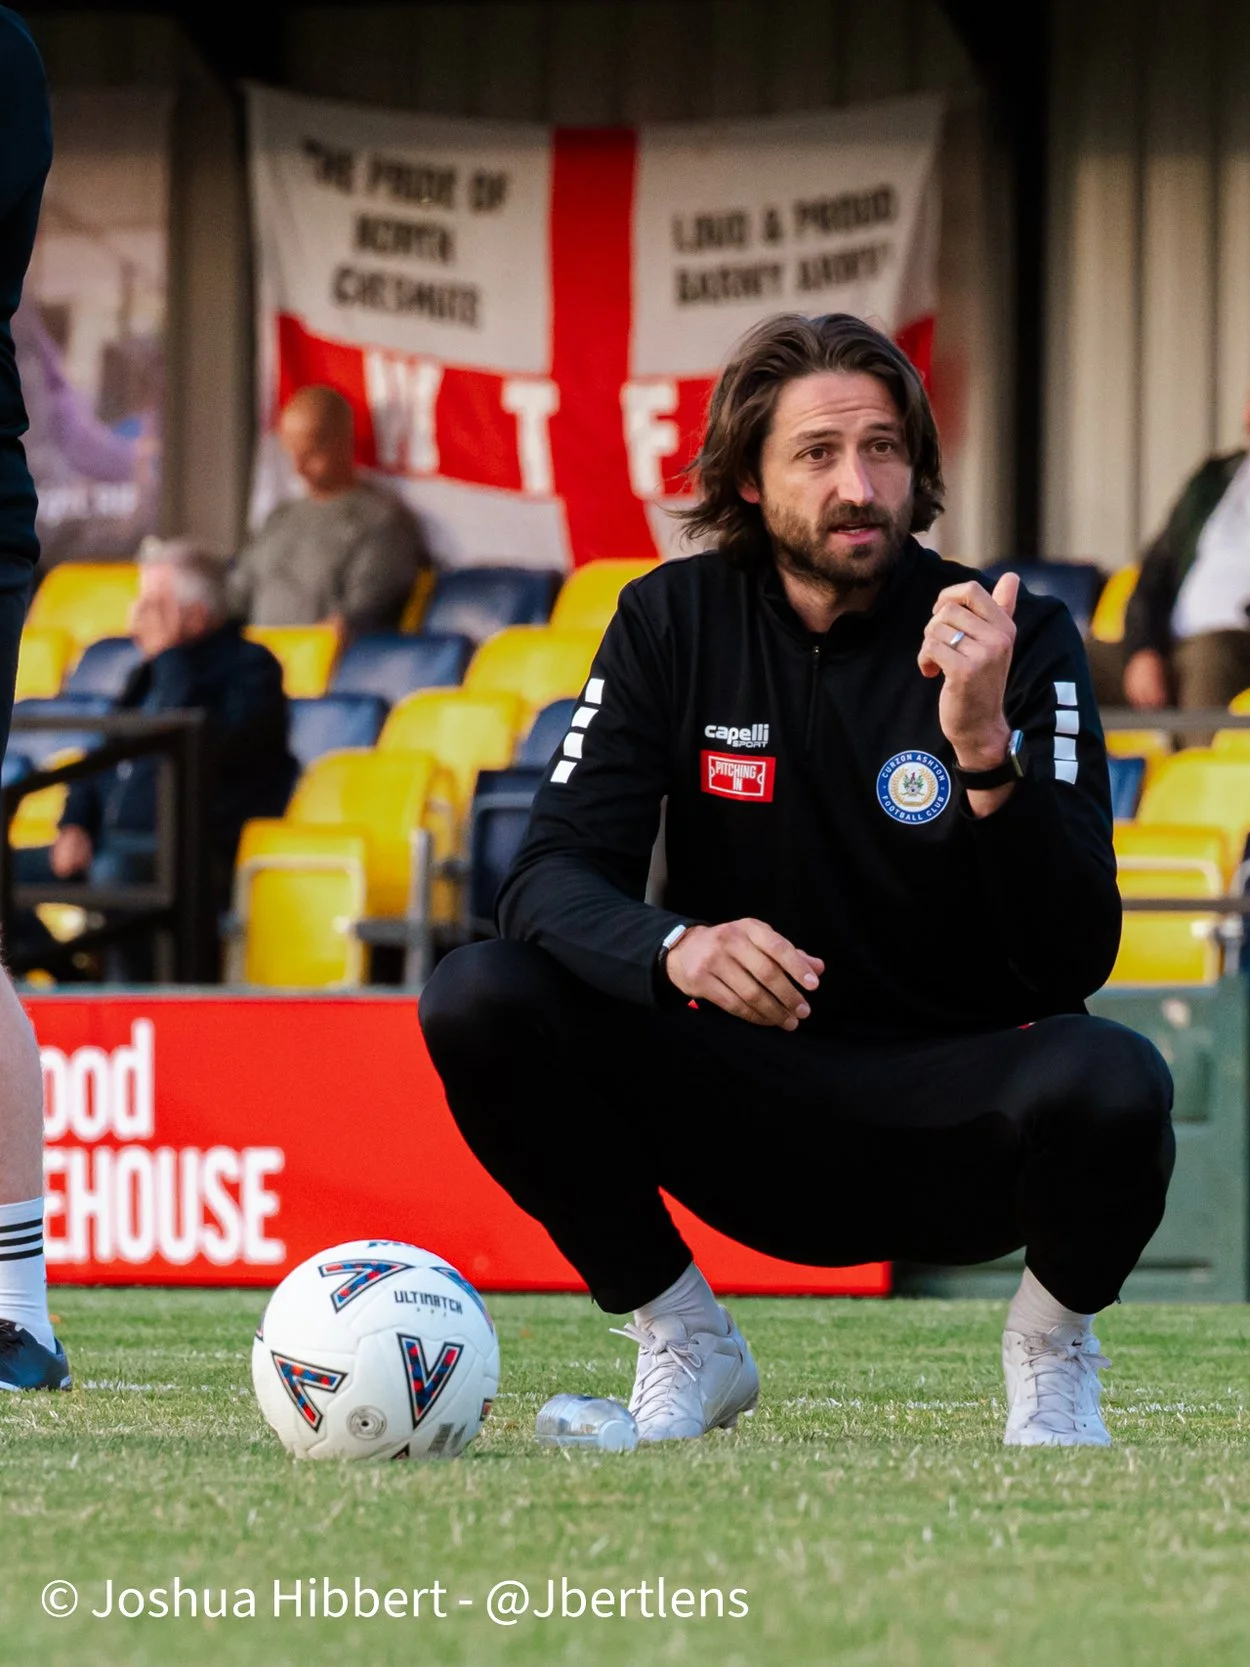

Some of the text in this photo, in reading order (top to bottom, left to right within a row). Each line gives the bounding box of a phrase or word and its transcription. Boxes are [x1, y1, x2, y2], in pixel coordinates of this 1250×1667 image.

[366, 156, 456, 209] PRIDE
[469, 172, 509, 215] OF
[673, 211, 748, 252] LOUD
[795, 184, 896, 234] PROUD
[354, 215, 454, 263] NORTH
[704, 723, 770, 745] capelli
[732, 740, 769, 748] SPORT
[715, 760, 757, 779] PITCHING
[881, 753, 946, 782] CURZON ASHTON
[732, 777, 744, 792] IN
[881, 795, 945, 821] FOOTBALL CLUB
[394, 1290, 463, 1315] ULTIMATCH
